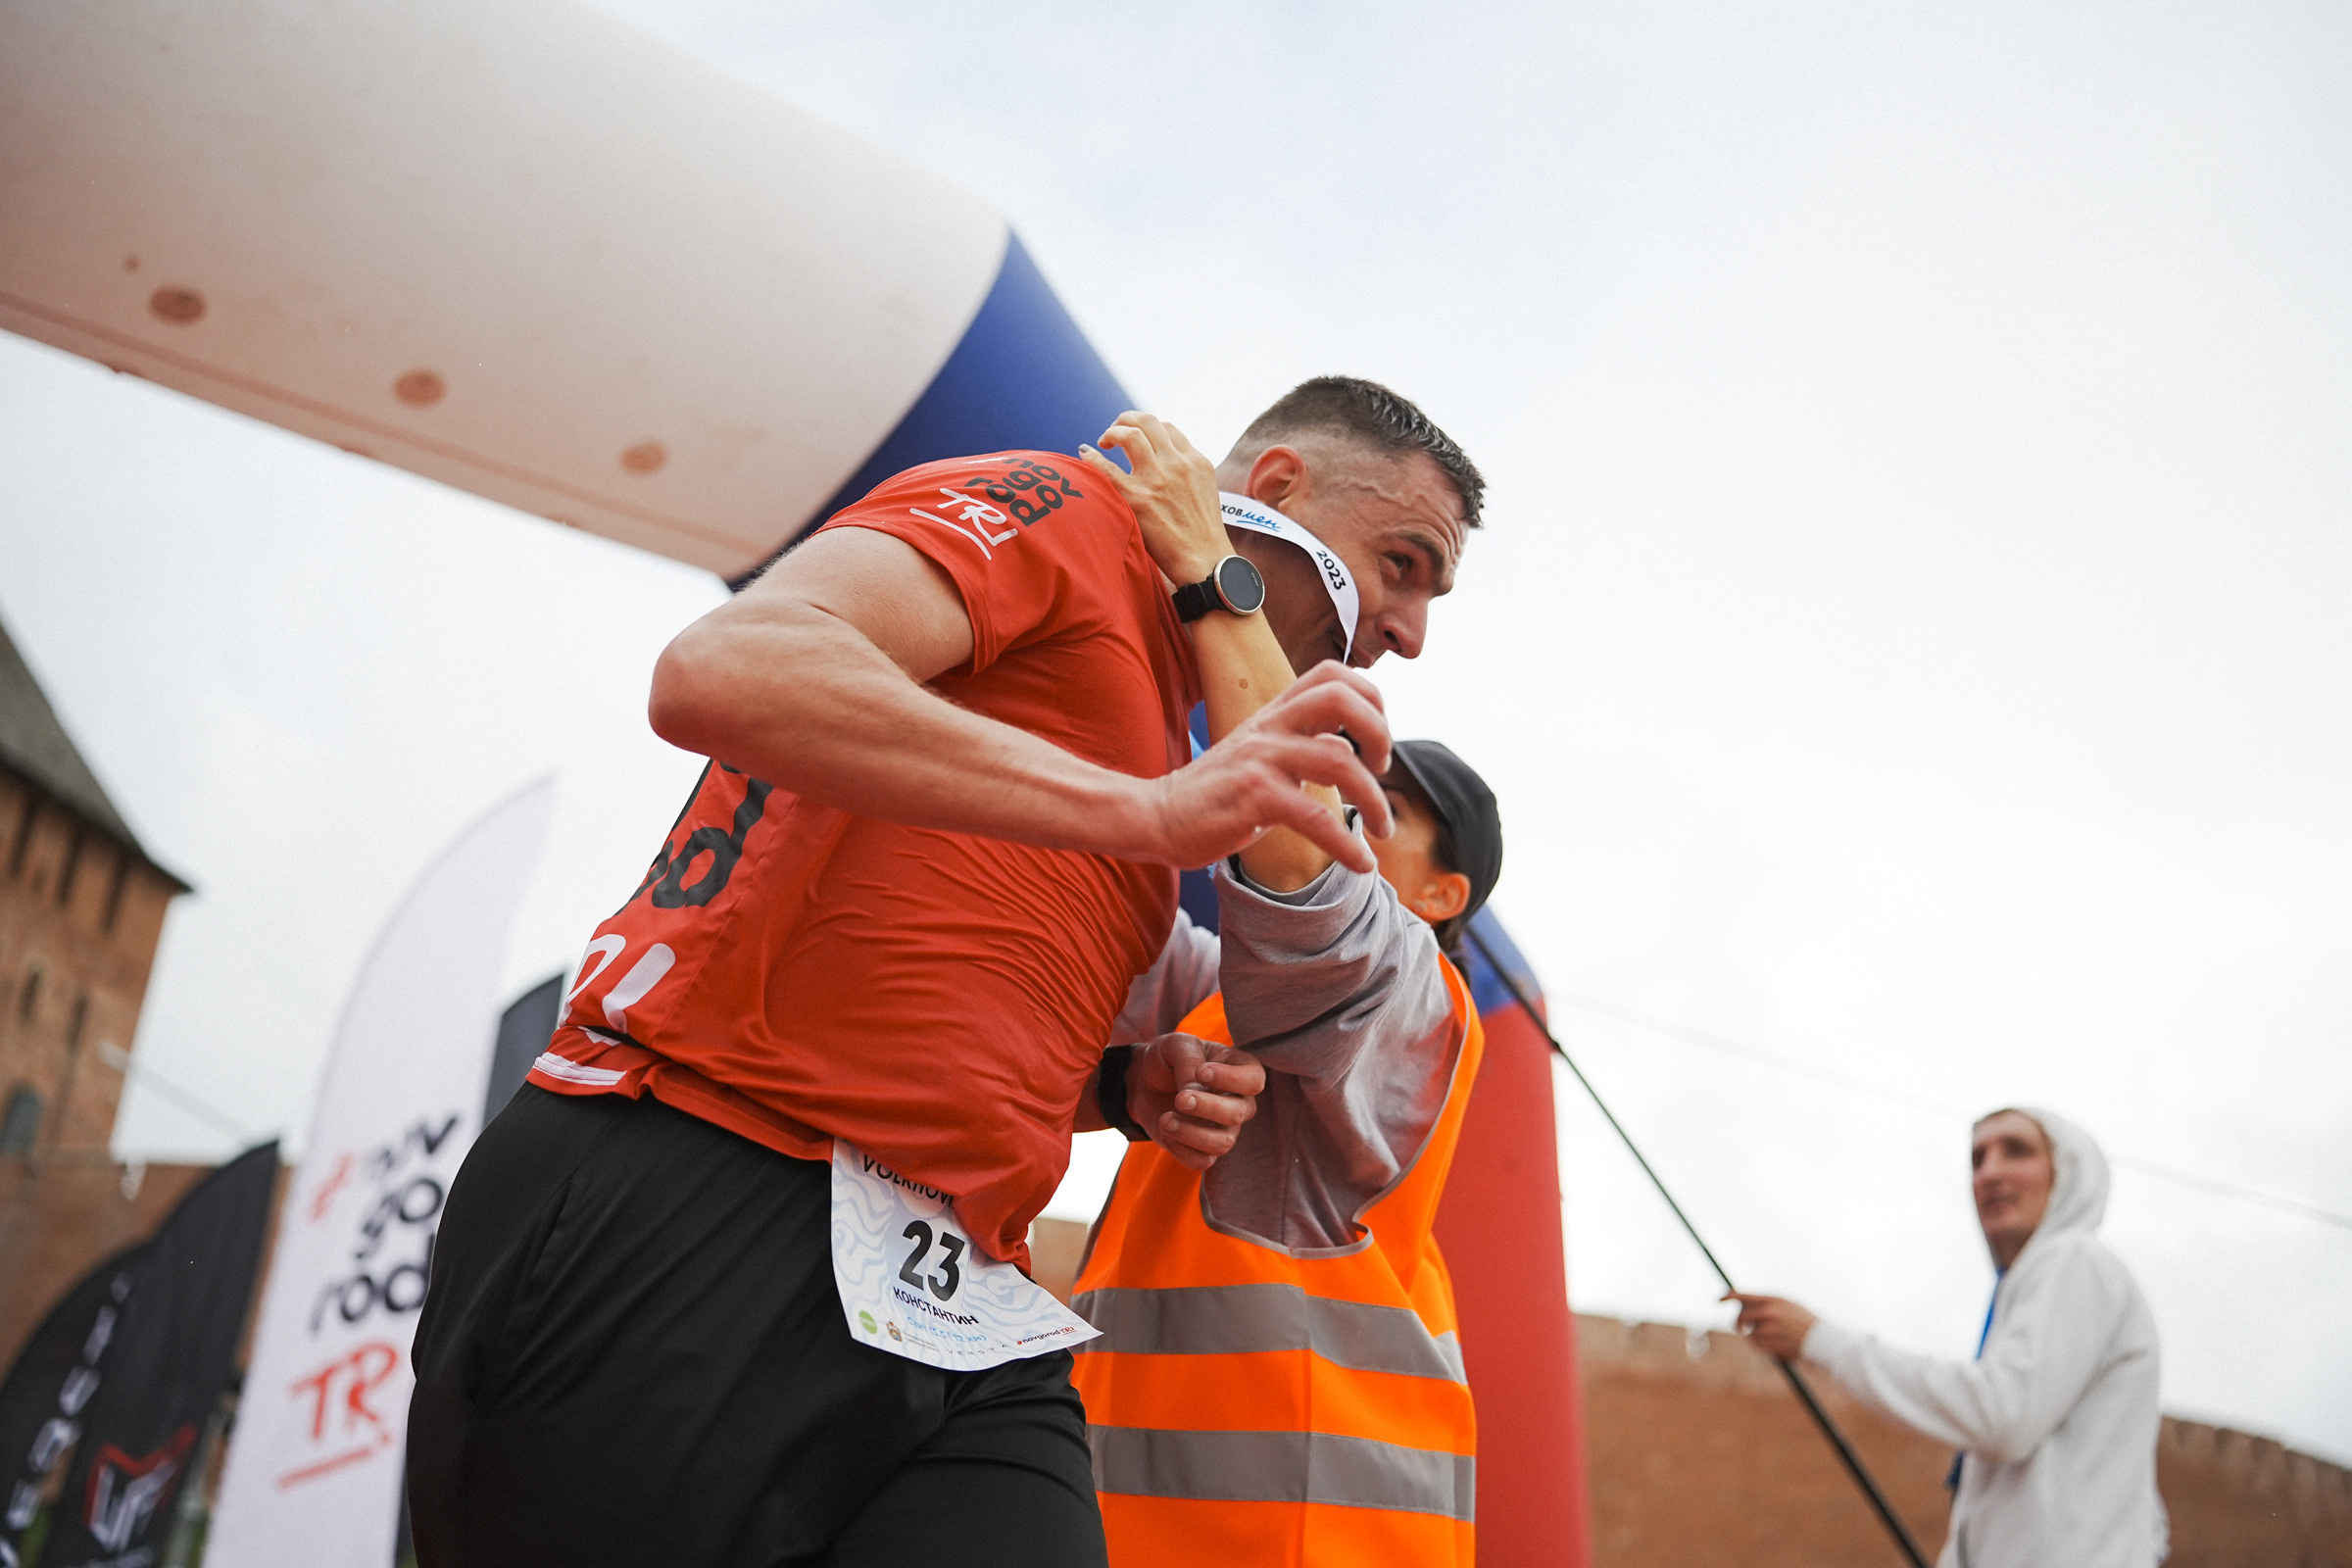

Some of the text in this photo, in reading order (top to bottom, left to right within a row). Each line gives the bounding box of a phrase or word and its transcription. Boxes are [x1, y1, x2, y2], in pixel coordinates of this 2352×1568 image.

[1315, 549, 1347, 591] 2023
[899, 1219, 965, 1302] 23
[893, 1286, 980, 1326] КОНСТАНТИН
